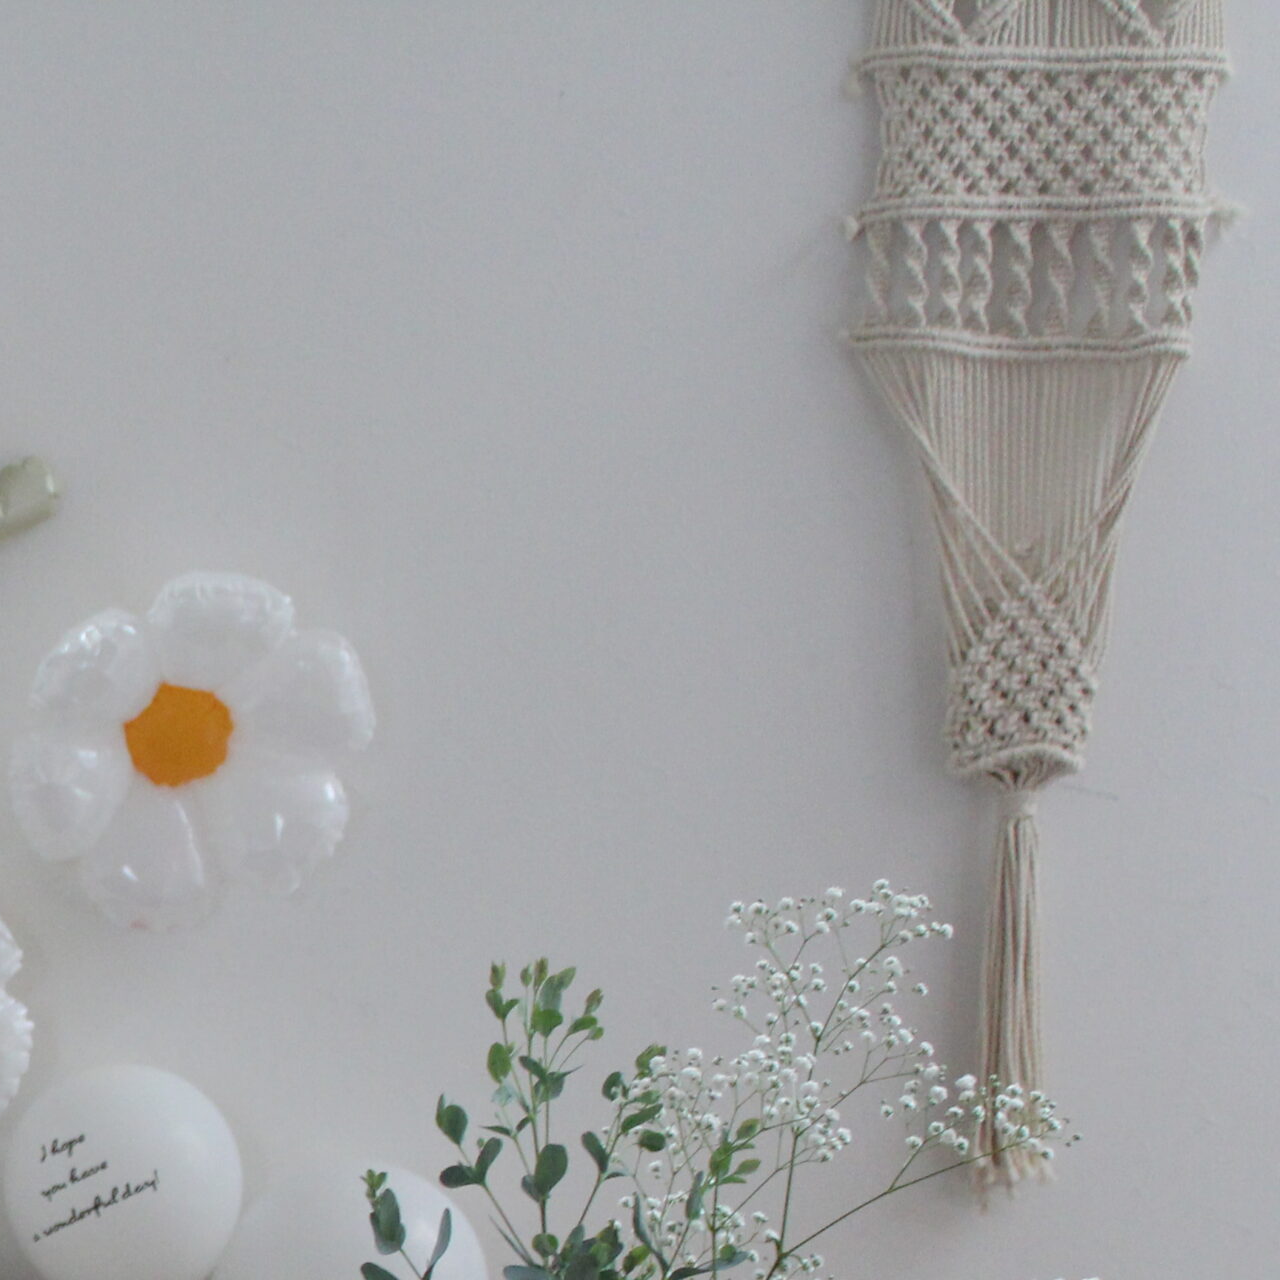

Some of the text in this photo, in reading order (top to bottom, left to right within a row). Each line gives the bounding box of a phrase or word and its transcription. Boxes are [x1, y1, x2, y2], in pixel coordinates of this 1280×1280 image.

[51, 1134, 85, 1157] hope
[40, 1161, 107, 1202] you have
[43, 1187, 119, 1236] wonderful
[122, 1169, 160, 1200] day!
